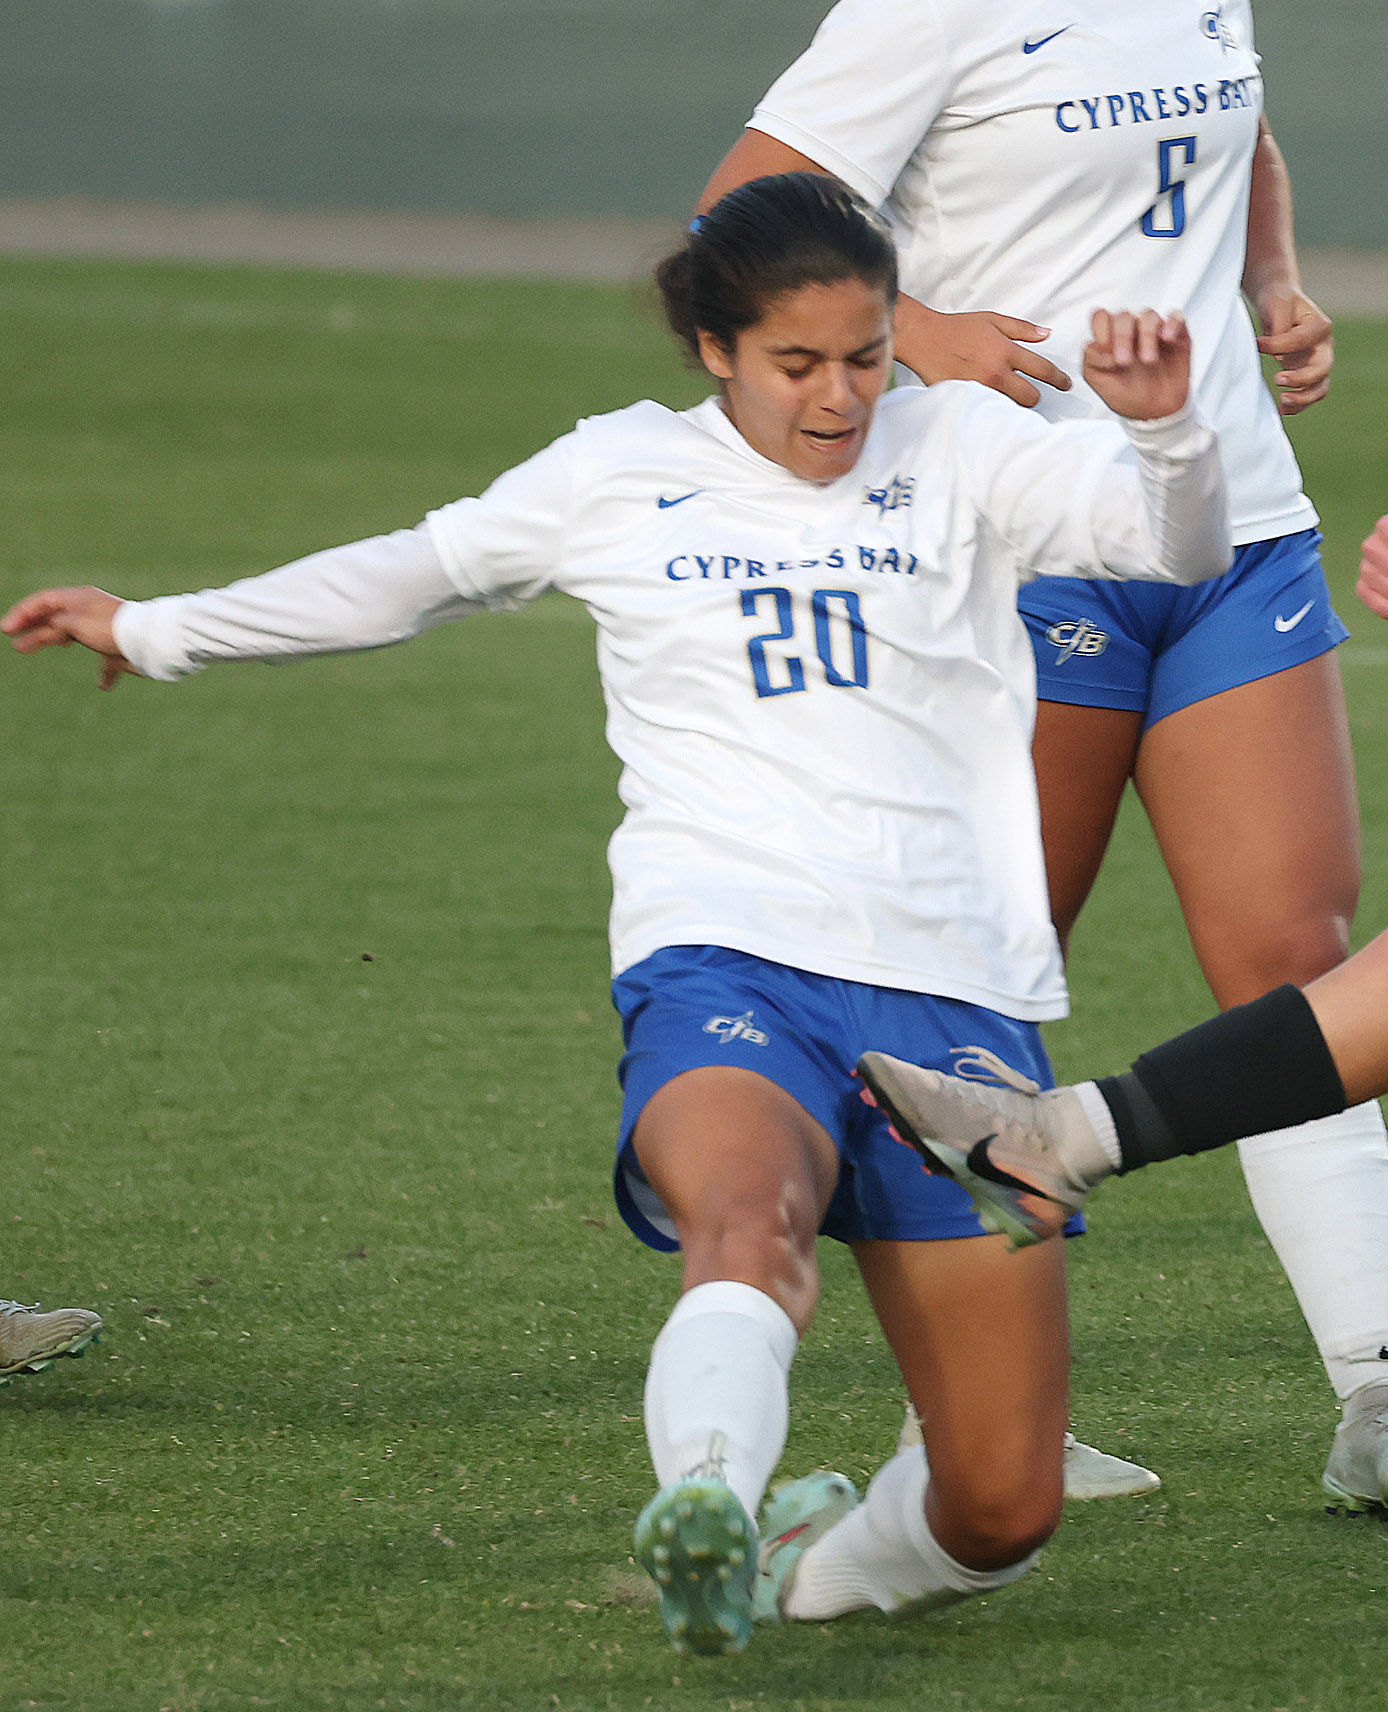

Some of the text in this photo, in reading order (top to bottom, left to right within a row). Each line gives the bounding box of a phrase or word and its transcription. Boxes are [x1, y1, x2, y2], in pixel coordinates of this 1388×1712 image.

[1055, 79, 1255, 133] CYPRESS BA
[739, 586, 870, 699] 20
